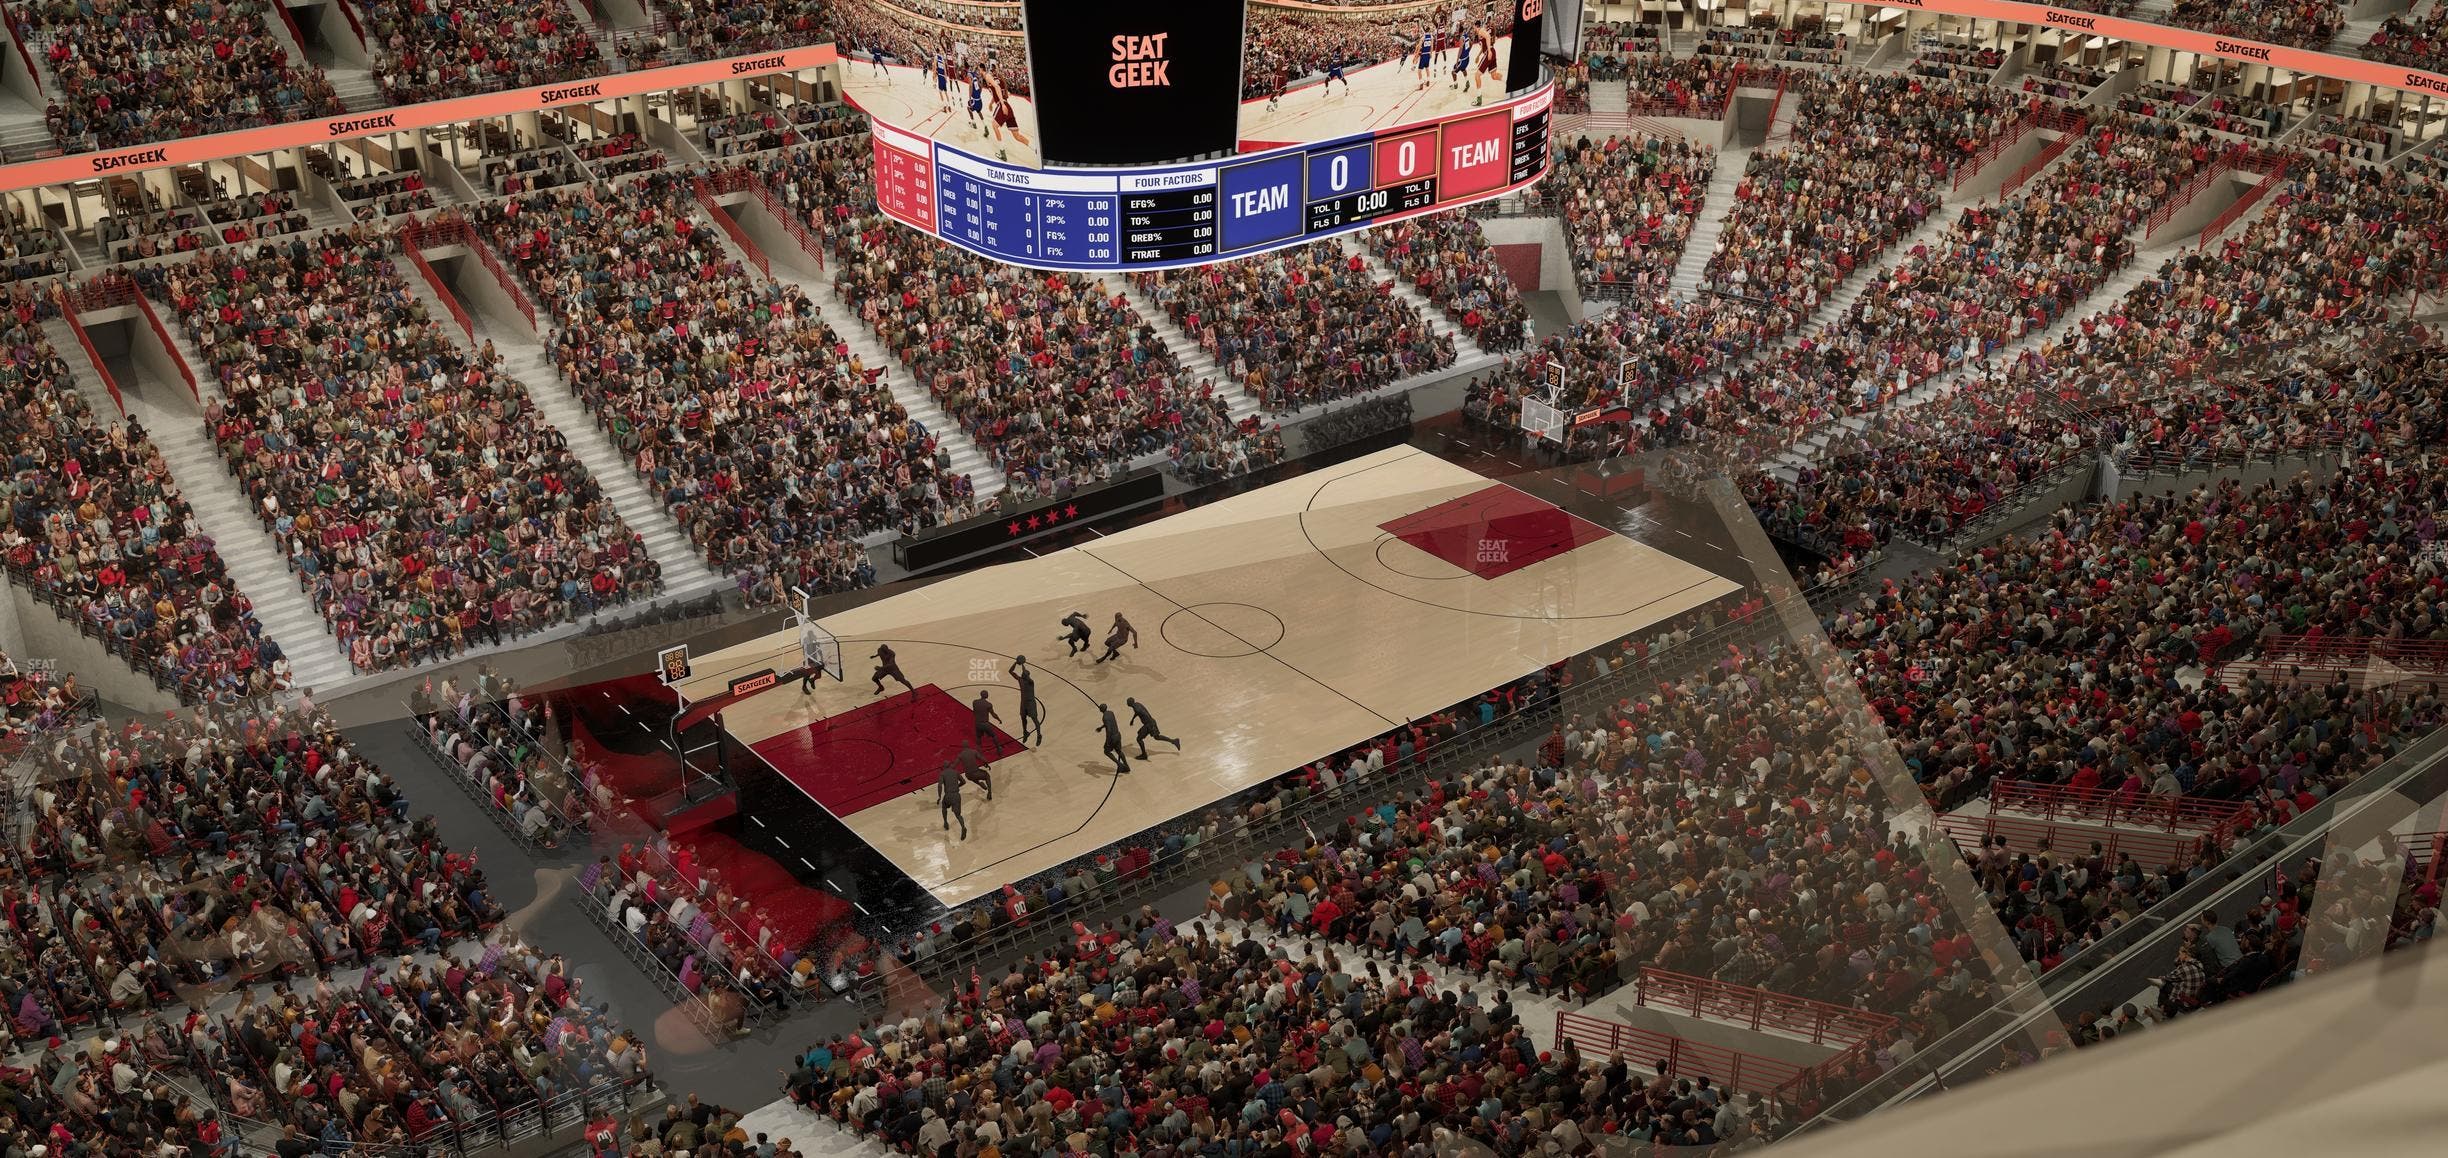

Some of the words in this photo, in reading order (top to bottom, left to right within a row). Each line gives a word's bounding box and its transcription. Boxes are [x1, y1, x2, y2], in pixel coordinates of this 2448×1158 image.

[2045, 11, 2096, 30] SEATGEEK
[1112, 32, 1168, 61] SEAT
[2215, 41, 2271, 61] SEATGEEK
[732, 55, 786, 74] SEATGEEK
[1109, 60, 1170, 88] GEEK
[541, 83, 601, 103] SEATGEEK
[329, 114, 396, 136] SEATGEEK
[92, 148, 168, 172] SEATGEEK
[1398, 141, 1415, 177] 0
[1451, 137, 1499, 170] TEAM
[987, 168, 1005, 181] TEAM
[1006, 173, 1029, 184] STATS
[1135, 177, 1160, 188] FOUR
[1163, 173, 1203, 186] FACTORS
[1331, 155, 1348, 191] 0
[965, 182, 977, 194] 0.00
[985, 189, 996, 199] BLK
[1405, 185, 1421, 194] TOL
[1424, 180, 1430, 191] 0
[966, 197, 978, 210] 0.00
[1045, 199, 1065, 208] 2P%
[1088, 201, 1108, 211] 0.00
[1130, 199, 1156, 209] EFG%
[1193, 193, 1212, 205] 0.00
[1231, 183, 1288, 219] TEAM
[1314, 205, 1330, 214] TOL
[1334, 200, 1340, 211] 0
[1357, 190, 1387, 213] 0:00
[1404, 198, 1420, 208] FLS
[1424, 194, 1429, 205] 0
[967, 213, 979, 225] 0.00
[1046, 215, 1066, 225] 3P%
[1088, 217, 1109, 227] 0.00
[1131, 216, 1150, 226] TO%
[1193, 209, 1212, 222] 0.00
[1313, 219, 1329, 230] FLS
[1334, 214, 1340, 225] 0
[967, 229, 979, 241] 0.00
[987, 237, 997, 247] STL
[1046, 231, 1066, 240] FG%
[1088, 233, 1109, 243] 0.00
[1131, 233, 1162, 243] OREB%
[1193, 226, 1212, 239] 0.00
[1089, 249, 1110, 259] 0.00
[1131, 250, 1160, 259] FTRATE
[1193, 243, 1212, 255] 0.00
[738, 676, 772, 693] SEATGEEK
[1014, 901, 1026, 916] 00
[862, 1053, 876, 1070] 00
